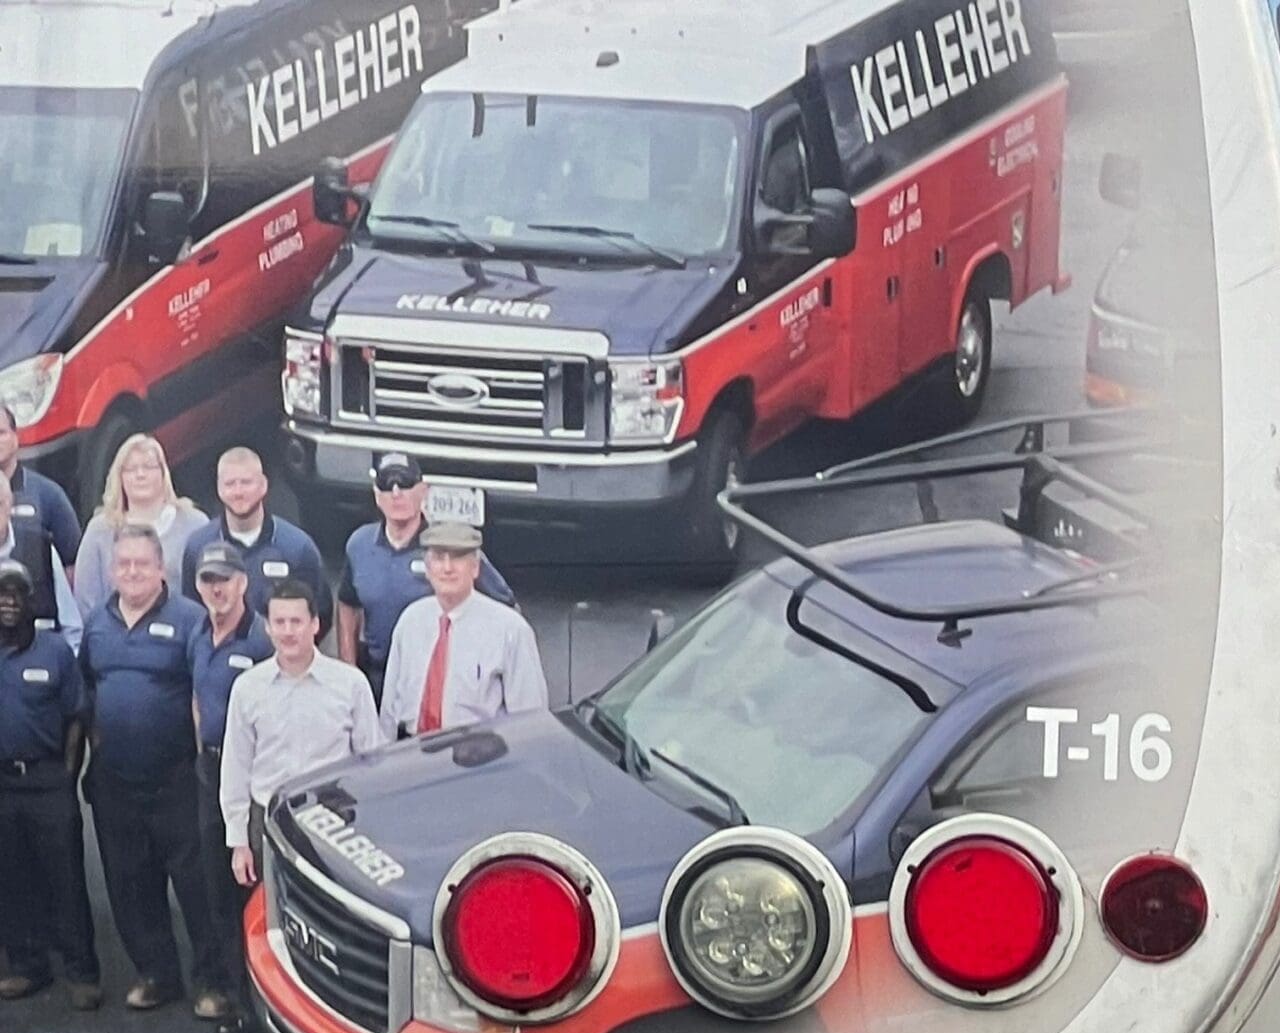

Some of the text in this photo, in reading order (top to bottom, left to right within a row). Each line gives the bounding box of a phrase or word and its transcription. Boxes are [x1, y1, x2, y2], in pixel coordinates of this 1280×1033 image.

[247, 4, 423, 155] KELLEHER
[851, 0, 1031, 144] KELLEHER
[396, 294, 551, 320] KELLEHER
[1026, 706, 1173, 782] T-16
[296, 804, 404, 886] KELLEHER
